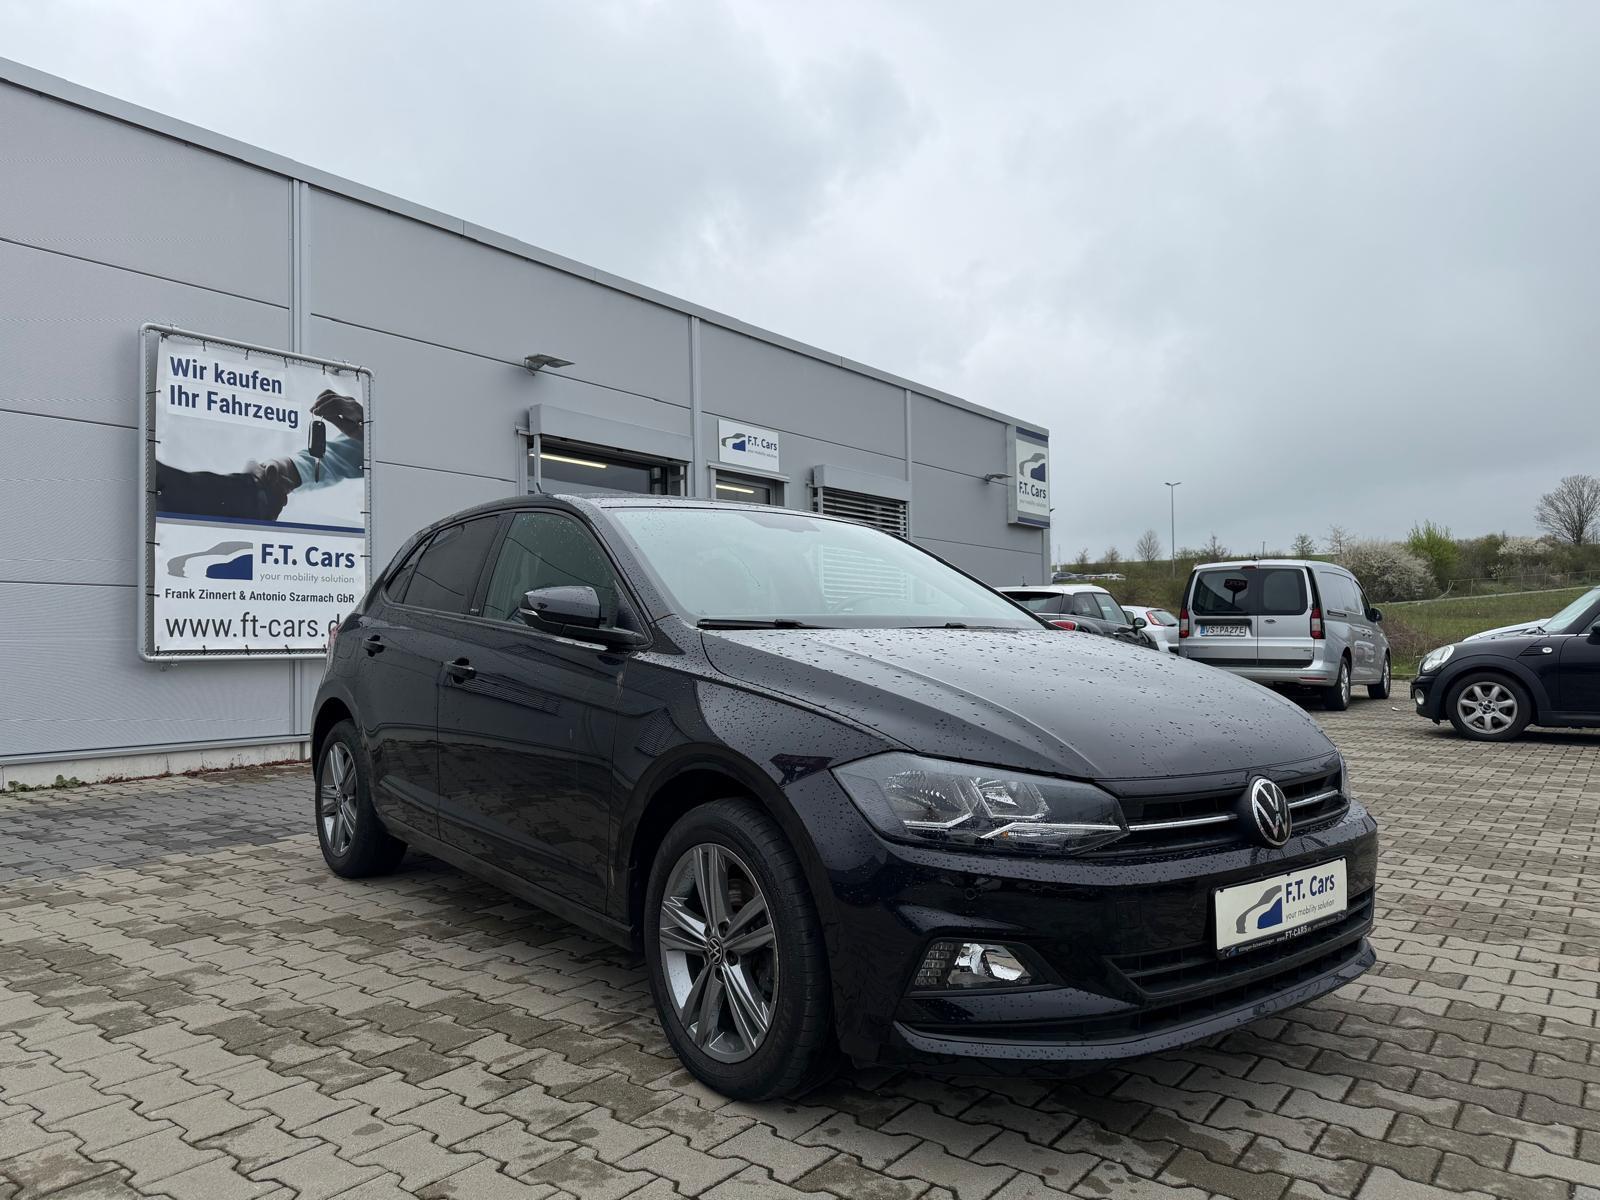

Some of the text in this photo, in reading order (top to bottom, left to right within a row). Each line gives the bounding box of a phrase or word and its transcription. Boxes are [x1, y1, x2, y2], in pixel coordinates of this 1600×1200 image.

[169, 356, 282, 394] Wir kaufen
[169, 385, 299, 429] Ihr Fahrzeug
[747, 436, 777, 451] F.T. Cars
[1019, 481, 1046, 499] F.T. Cars
[261, 543, 355, 569] F.T. Cars
[260, 573, 355, 584] your mobility solution
[165, 588, 355, 604] Frank Zinnert & Antonio Szarmach GbR
[1285, 874, 1335, 903] F.T. Cars
[1286, 899, 1334, 921] your mobility solution
